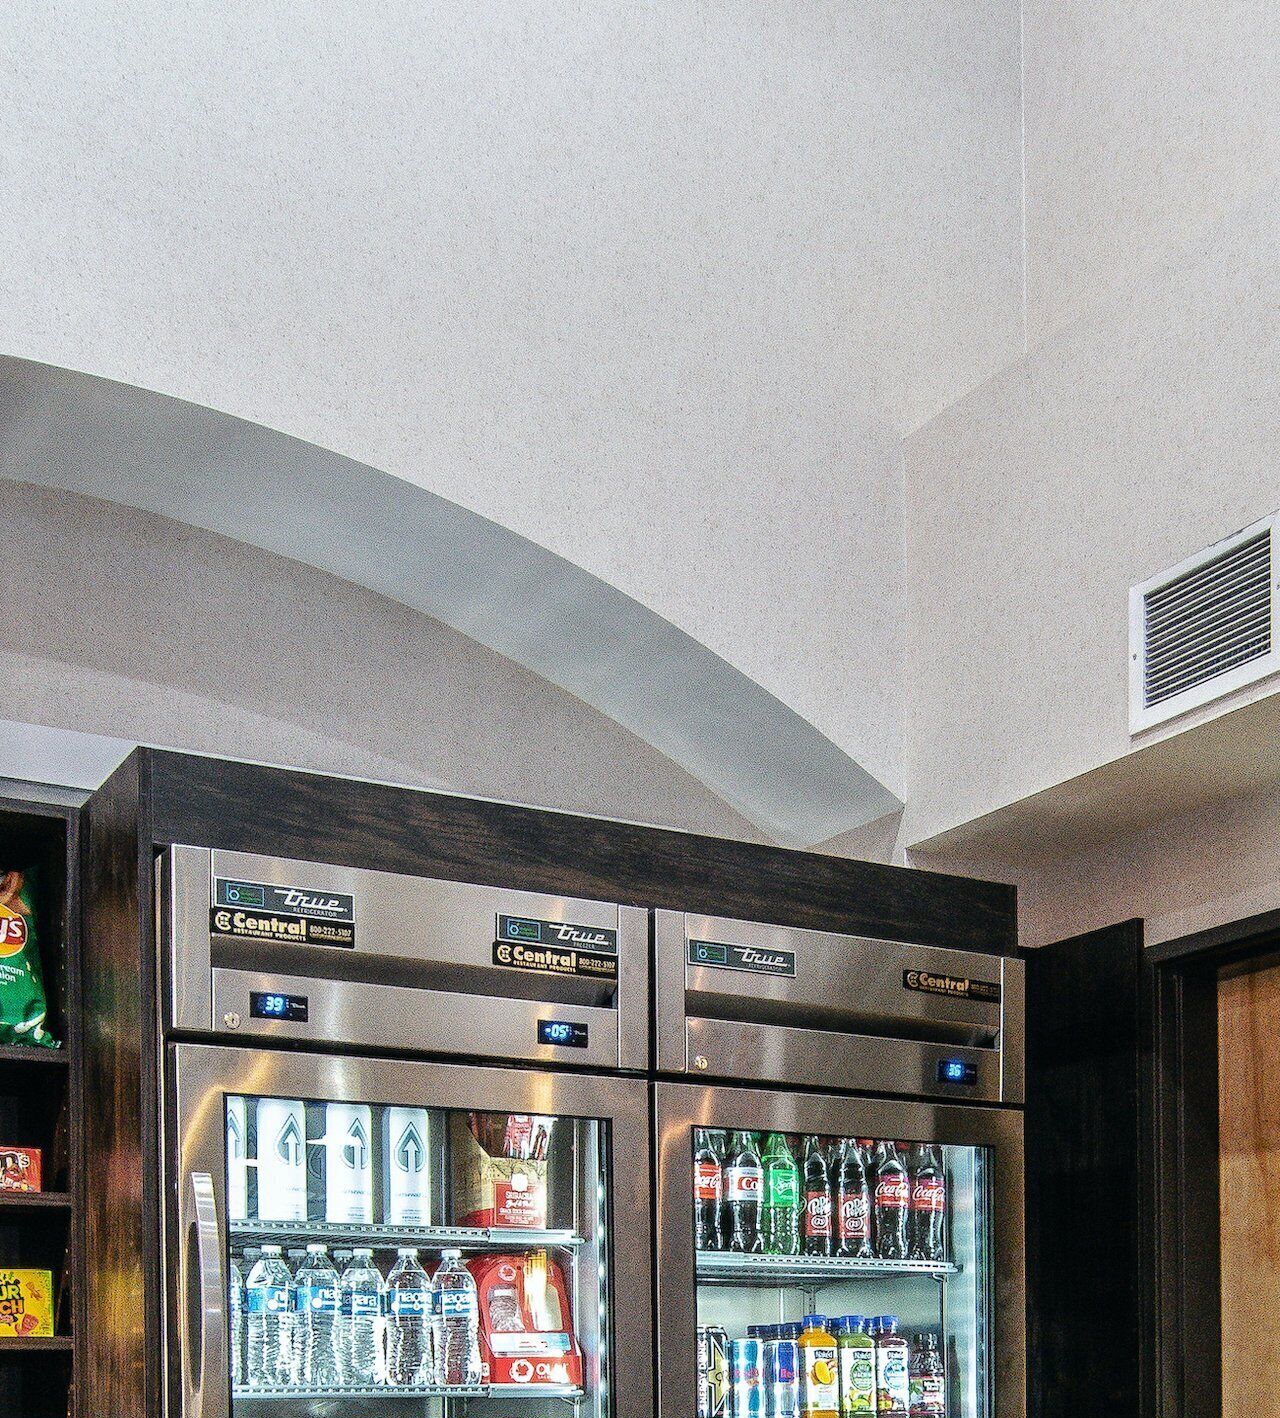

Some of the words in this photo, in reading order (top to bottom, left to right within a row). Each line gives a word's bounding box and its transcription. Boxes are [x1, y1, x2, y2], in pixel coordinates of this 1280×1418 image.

[234, 912, 306, 935] Central
[234, 928, 273, 937] RESTAURANT
[275, 933, 306, 941] PRODUCTS
[513, 946, 576, 967] Central
[513, 960, 548, 969] RESTAURANT
[549, 965, 576, 973] PRODUCTS
[920, 973, 969, 991] Central
[266, 996, 283, 1011] 39
